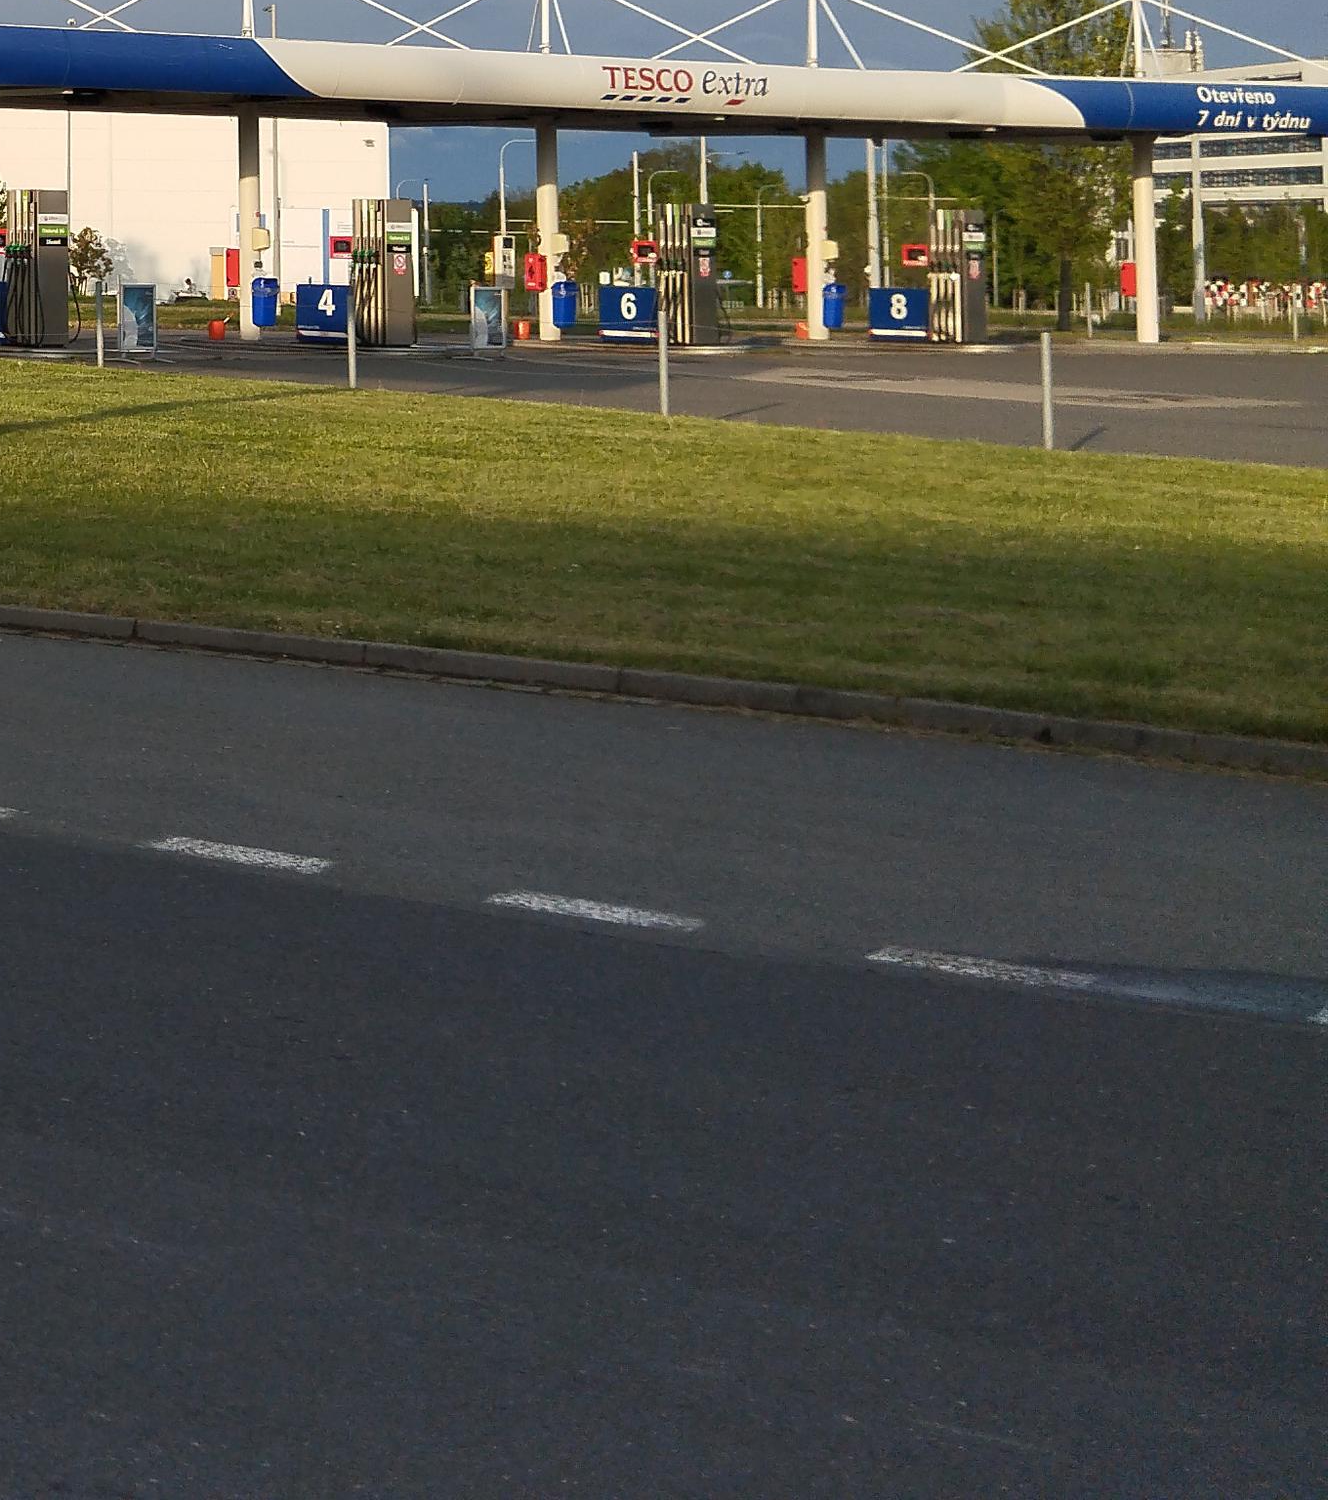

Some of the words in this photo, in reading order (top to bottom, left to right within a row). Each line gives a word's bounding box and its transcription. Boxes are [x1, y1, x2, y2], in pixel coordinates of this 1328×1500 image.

[602, 66, 693, 93] TESCO
[702, 70, 769, 97] extra
[1196, 86, 1277, 105] Otevřeno
[1197, 110, 1210, 127] 7
[1213, 110, 1243, 128] dní
[1247, 115, 1256, 128] v
[1262, 110, 1311, 131] týdnu
[317, 289, 336, 316] 4
[620, 293, 637, 320] 6
[890, 293, 908, 320] 8
